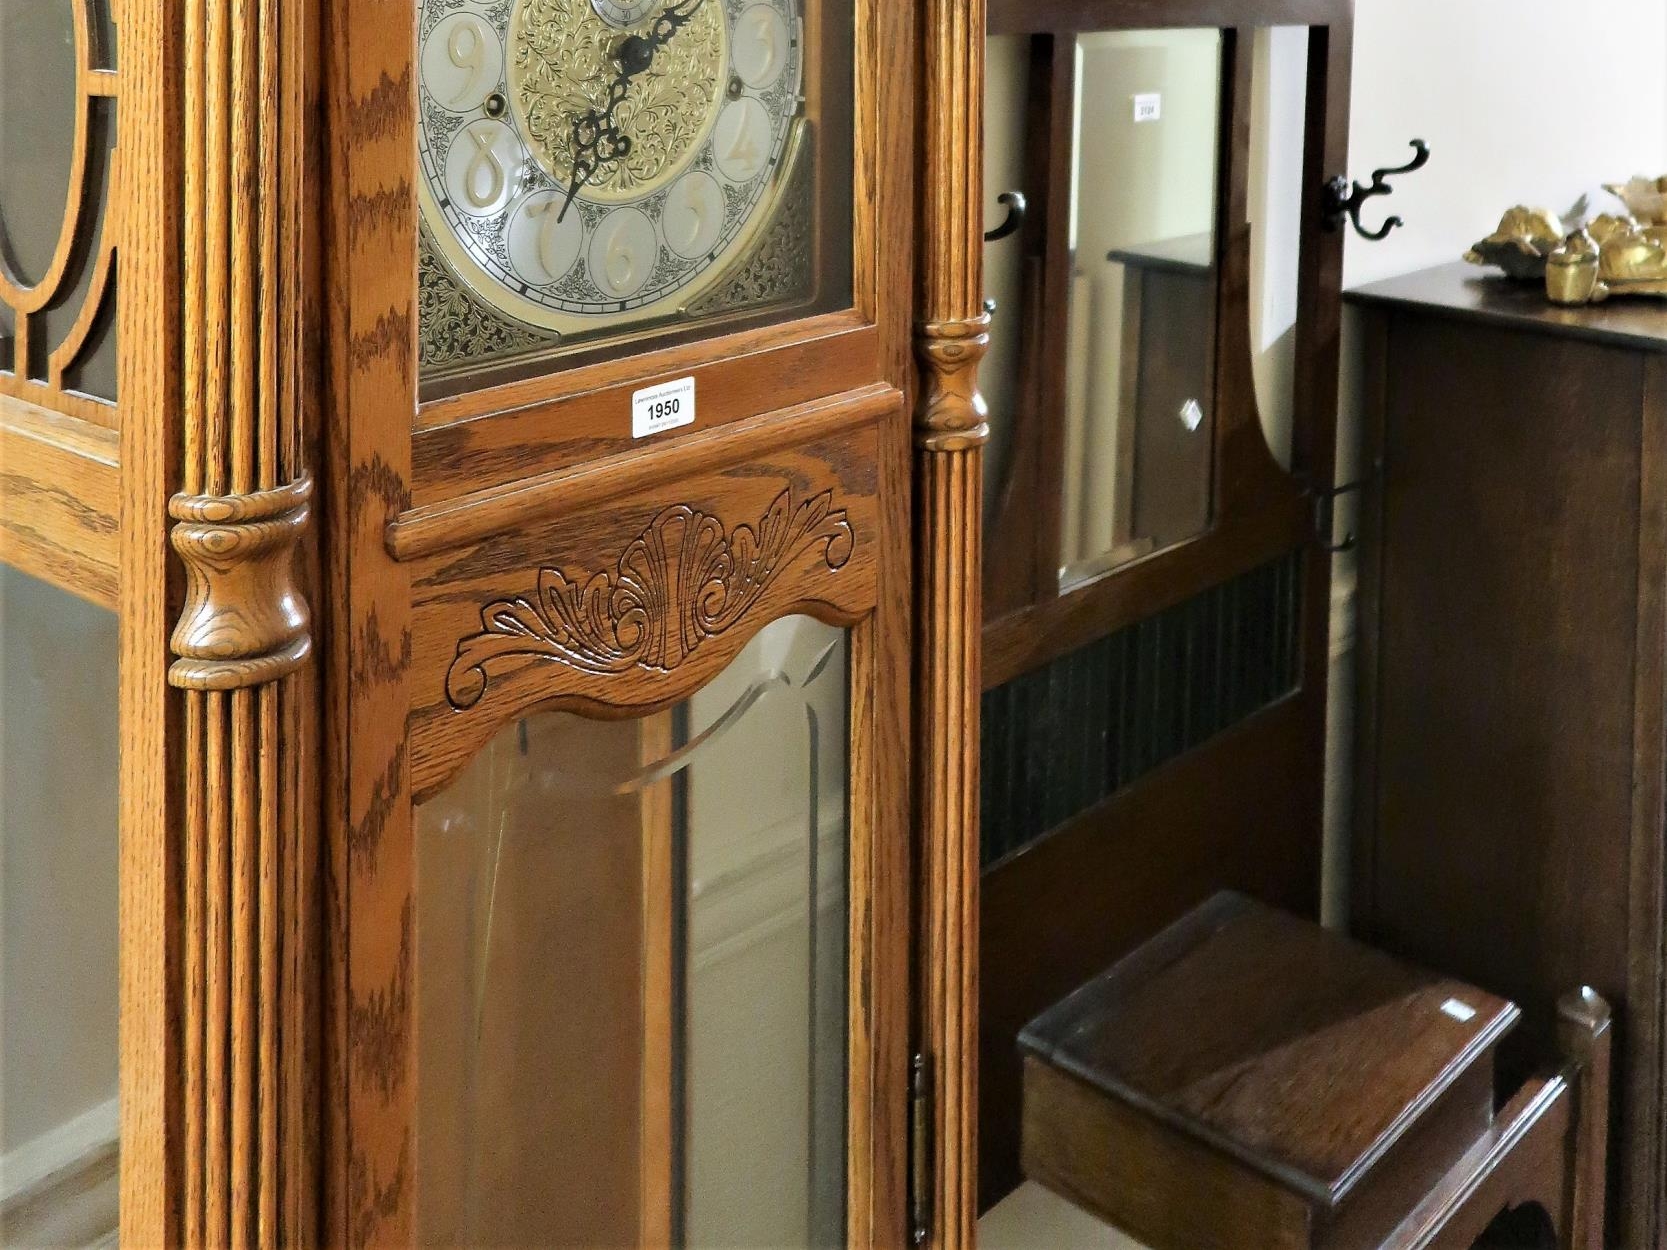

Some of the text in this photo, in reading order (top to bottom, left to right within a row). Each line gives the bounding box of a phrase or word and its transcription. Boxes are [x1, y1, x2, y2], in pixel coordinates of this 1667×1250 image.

[447, 19, 485, 105] 9
[750, 10, 776, 85] 3
[465, 129, 505, 208] 8
[721, 102, 758, 172] 4
[525, 200, 558, 281] 7
[604, 222, 631, 292] 6
[648, 398, 680, 420] 1950
